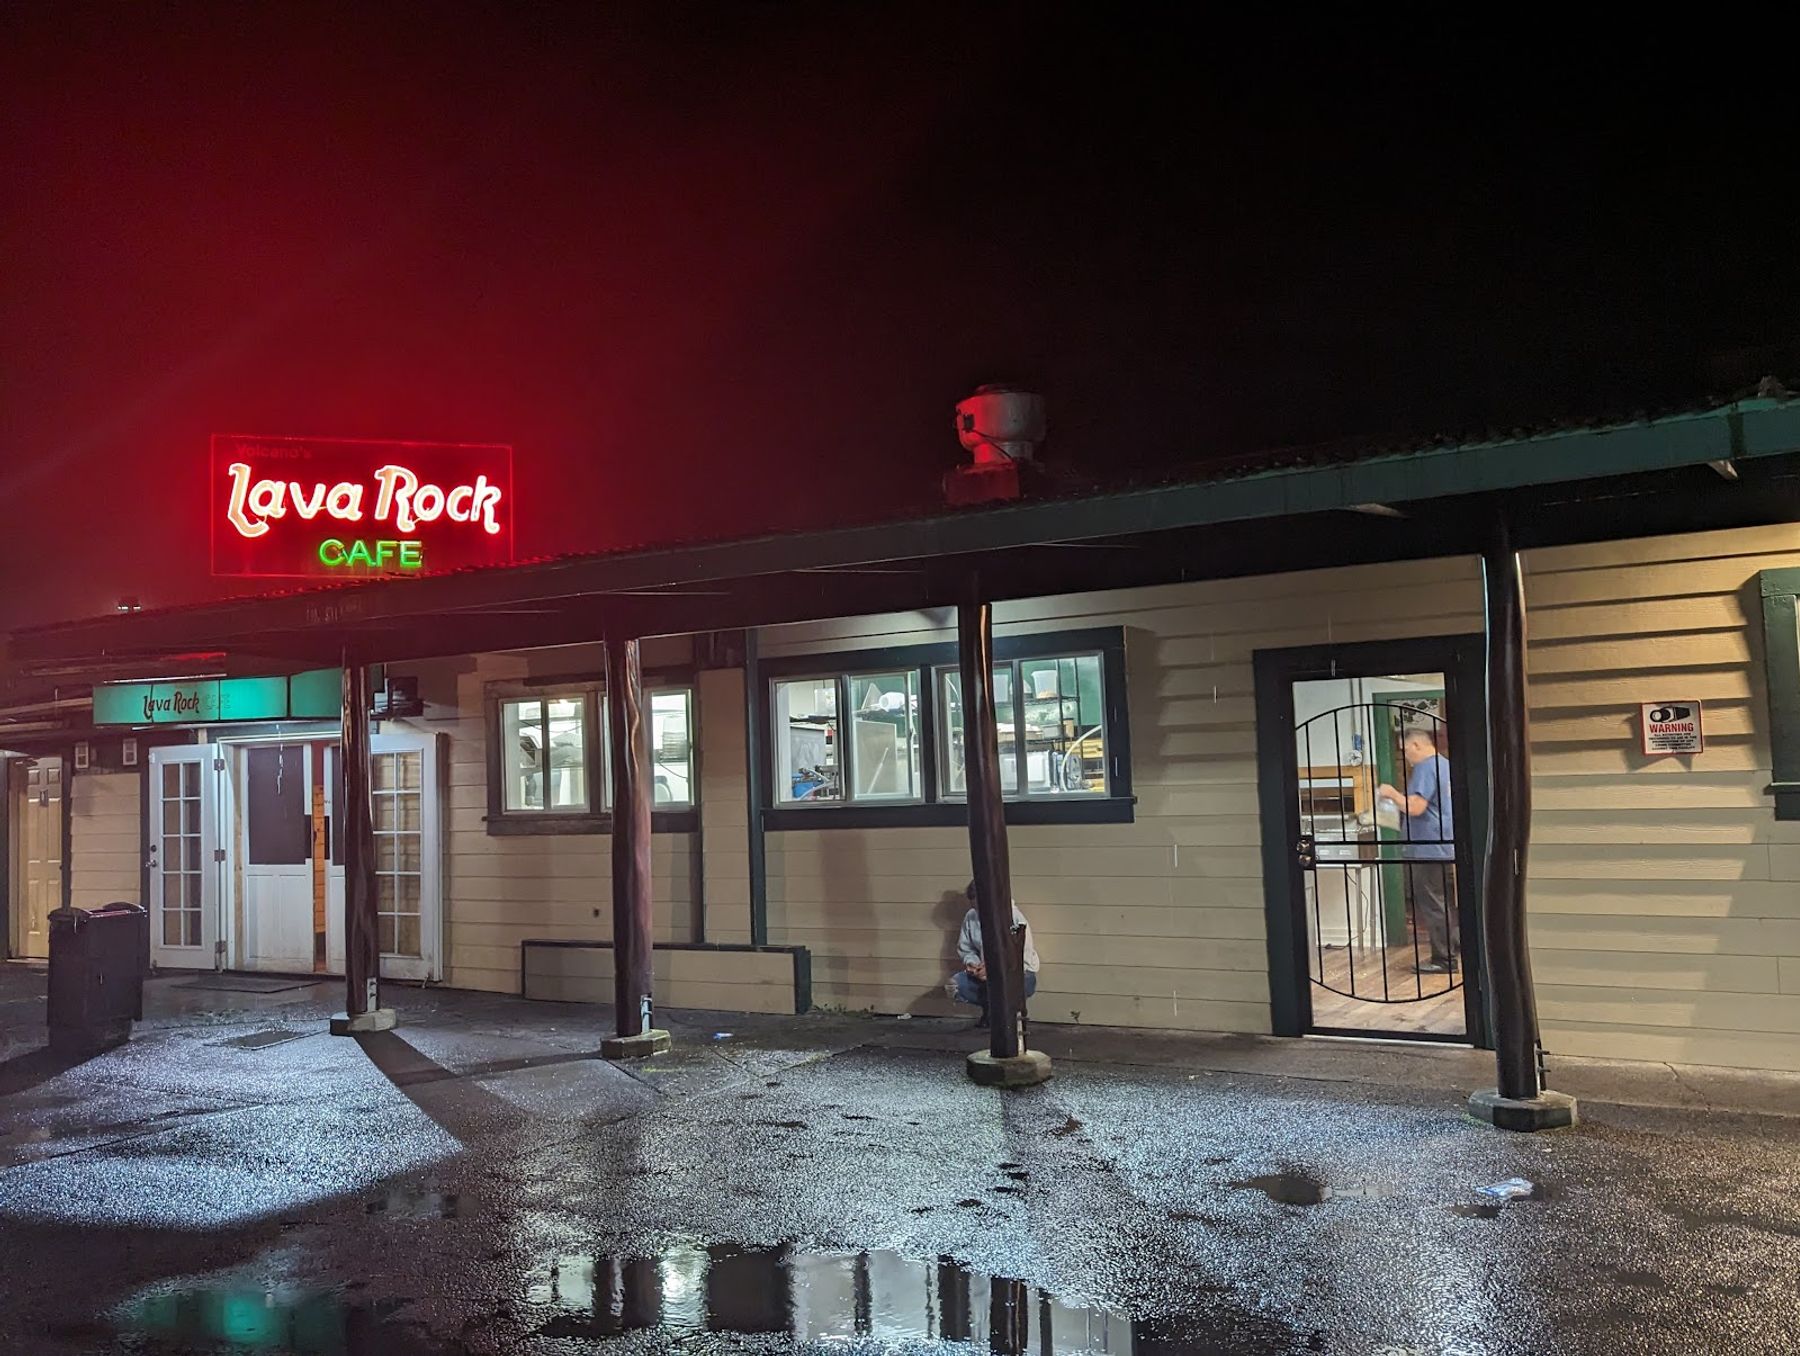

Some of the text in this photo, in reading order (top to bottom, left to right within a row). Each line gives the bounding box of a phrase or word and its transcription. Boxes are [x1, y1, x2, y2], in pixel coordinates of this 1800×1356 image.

[228, 462, 502, 537] Lava Rock
[319, 538, 422, 568] CAFE
[143, 695, 171, 720] Lava
[173, 691, 200, 714] Rock
[1649, 722, 1694, 733] WARNING
